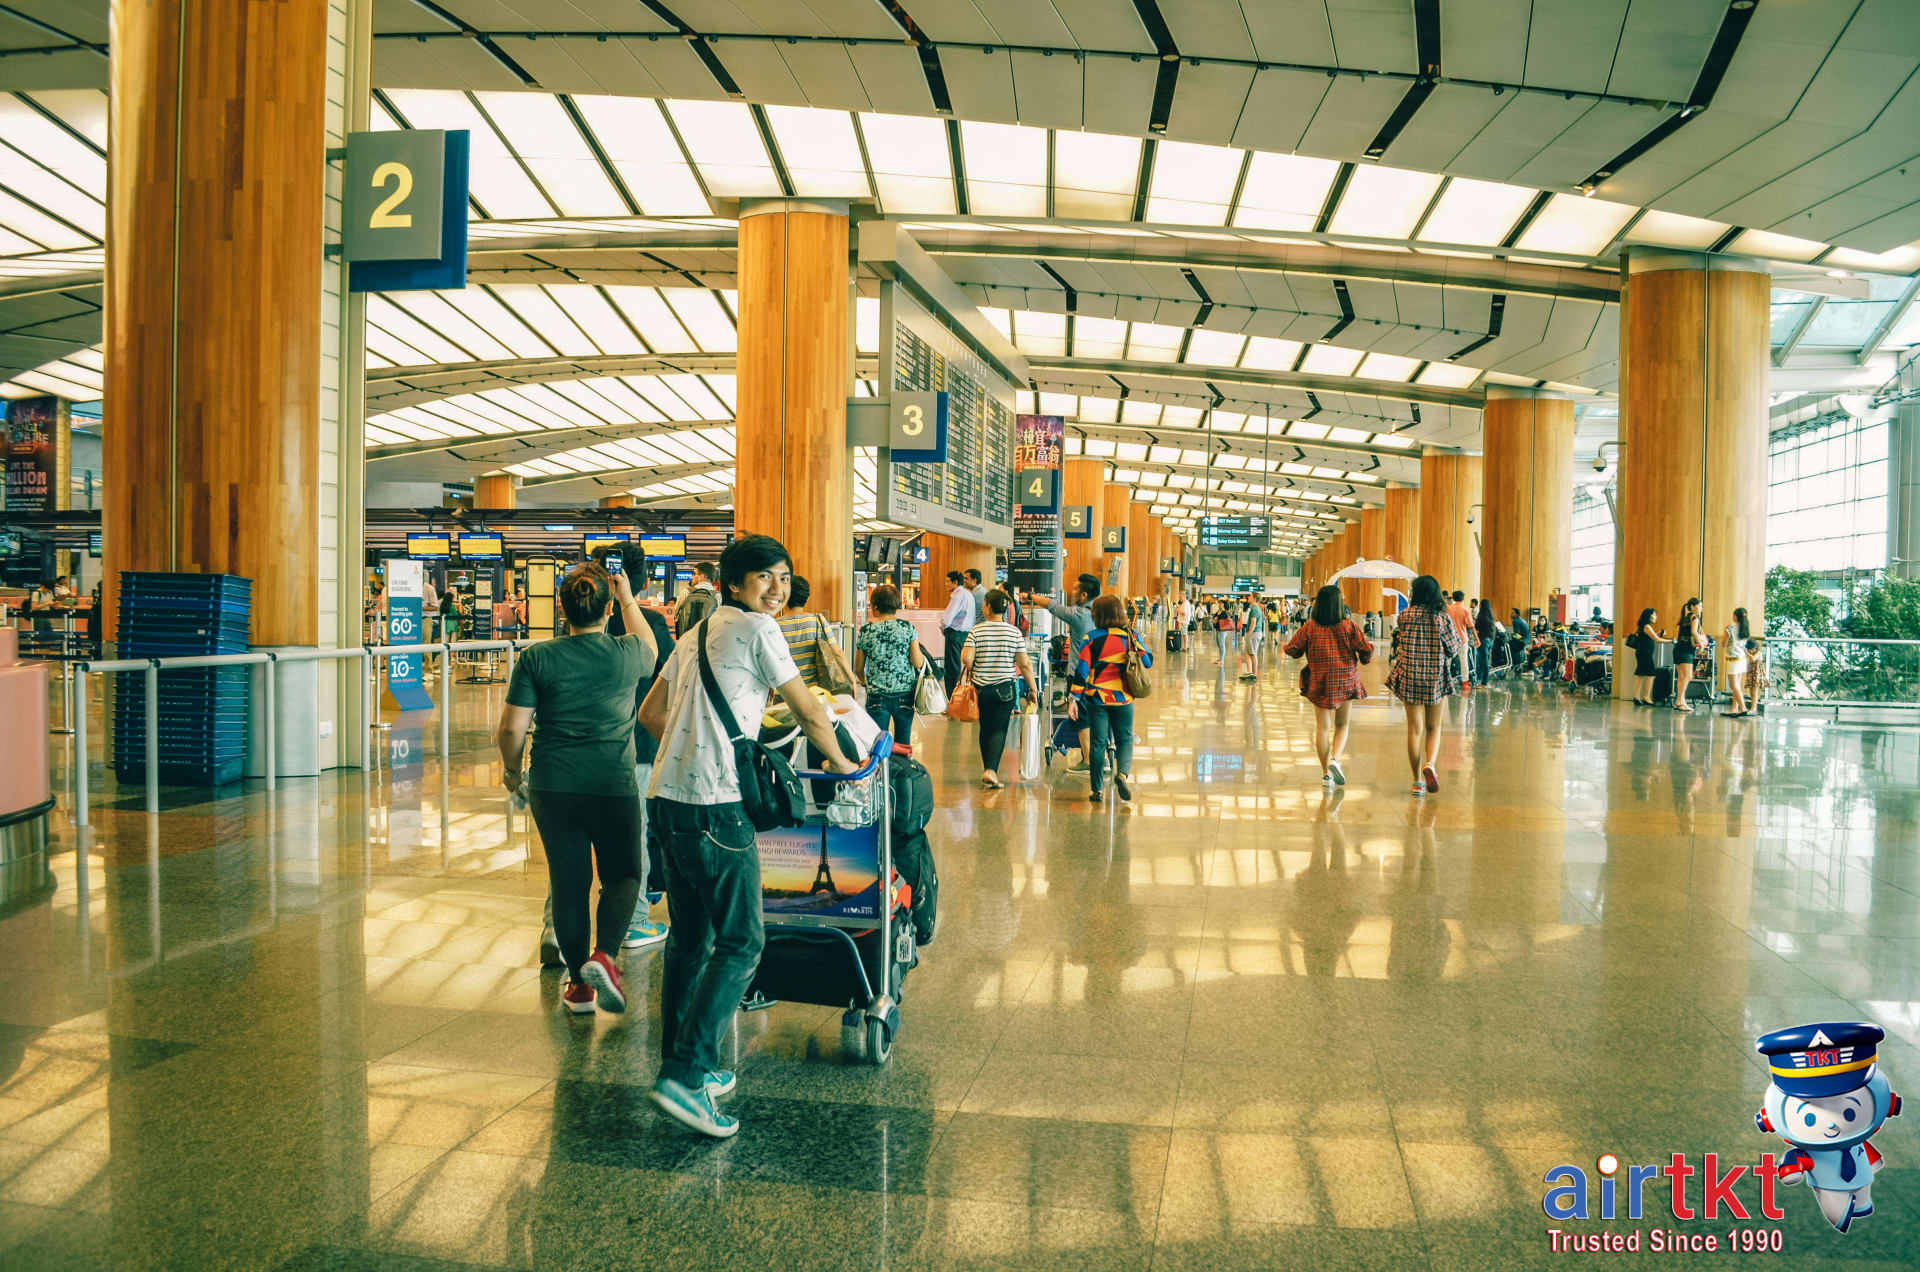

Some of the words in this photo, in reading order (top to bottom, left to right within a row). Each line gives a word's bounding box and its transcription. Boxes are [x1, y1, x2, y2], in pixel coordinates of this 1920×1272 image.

[370, 162, 413, 228] 2
[902, 404, 924, 436] 3
[1028, 477, 1044, 497] 4
[1070, 512, 1081, 527] 5
[1108, 531, 1118, 543] 6
[916, 549, 927, 562] 4
[1163, 559, 1169, 568] 7
[391, 618, 412, 635] 60
[391, 661, 409, 678] 10
